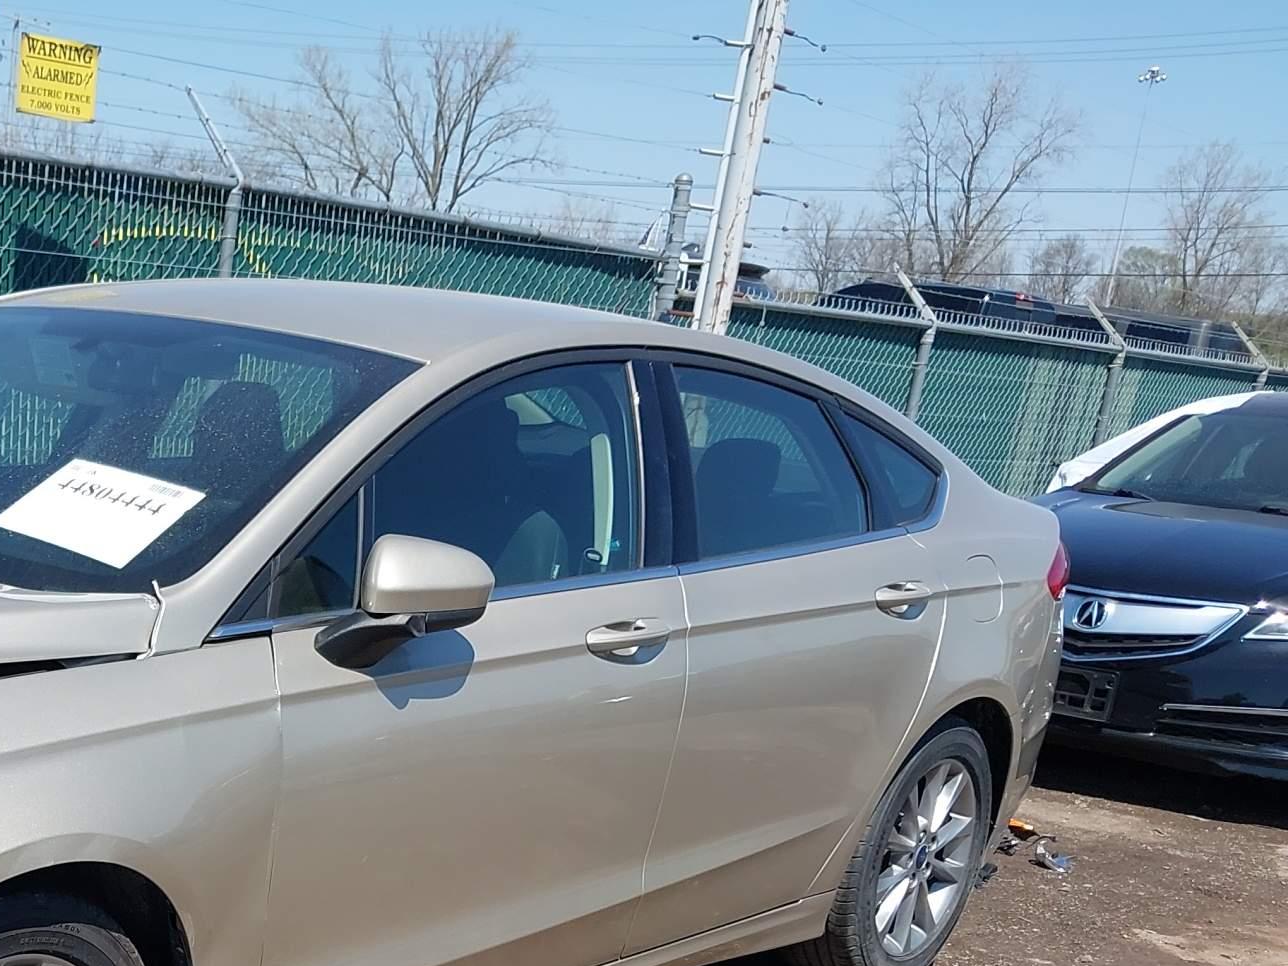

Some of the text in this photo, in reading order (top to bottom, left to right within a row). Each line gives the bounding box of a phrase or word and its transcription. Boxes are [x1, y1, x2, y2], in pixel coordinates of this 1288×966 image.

[27, 36, 94, 64] WARNING
[32, 65, 83, 86] ALARMED
[20, 84, 91, 104] ELECTRIC FENCE
[54, 103, 81, 115] VOLTS
[57, 478, 167, 515] 44804444
